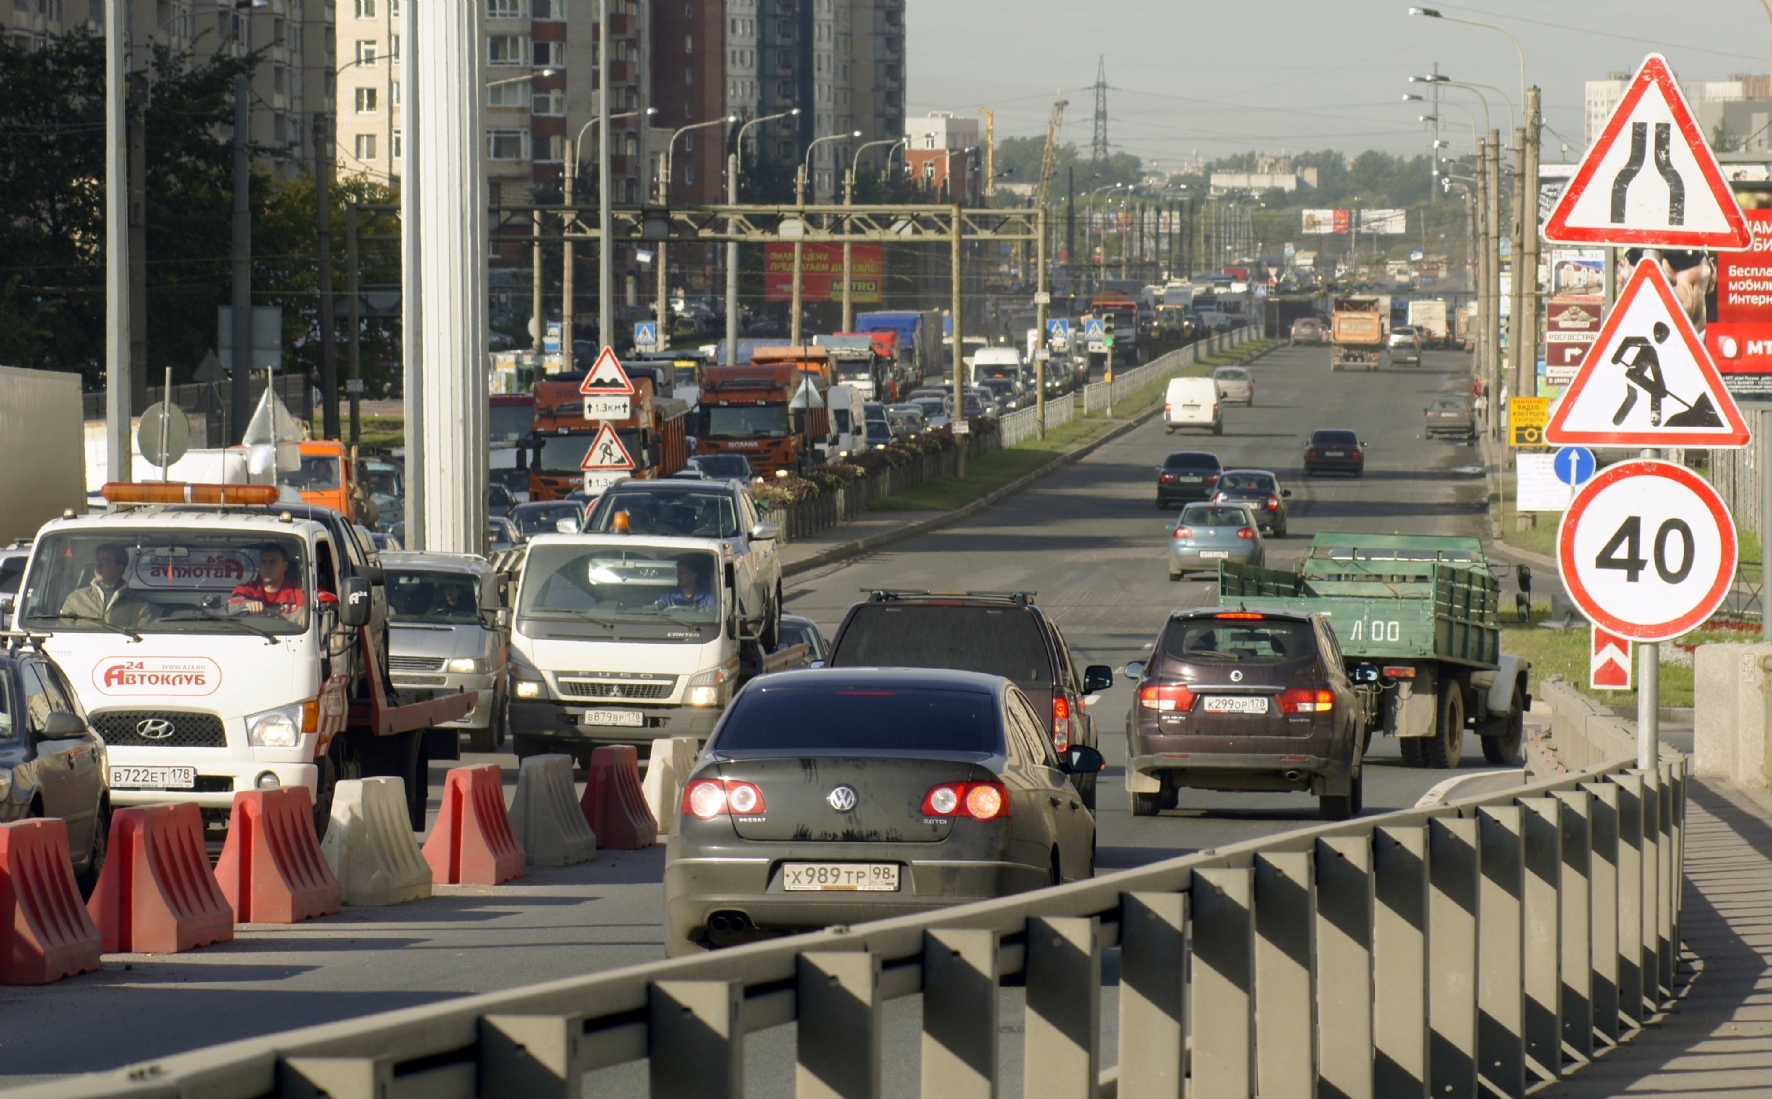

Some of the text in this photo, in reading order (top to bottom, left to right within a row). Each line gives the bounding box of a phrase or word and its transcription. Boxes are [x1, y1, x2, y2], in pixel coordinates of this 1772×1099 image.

[1749, 220, 1772, 234] АМ
[1754, 237, 1772, 251] БИ
[770, 263, 829, 272] ПРЕДАГАЕМ
[833, 282, 876, 290] MTRO
[1595, 515, 1695, 584] 40
